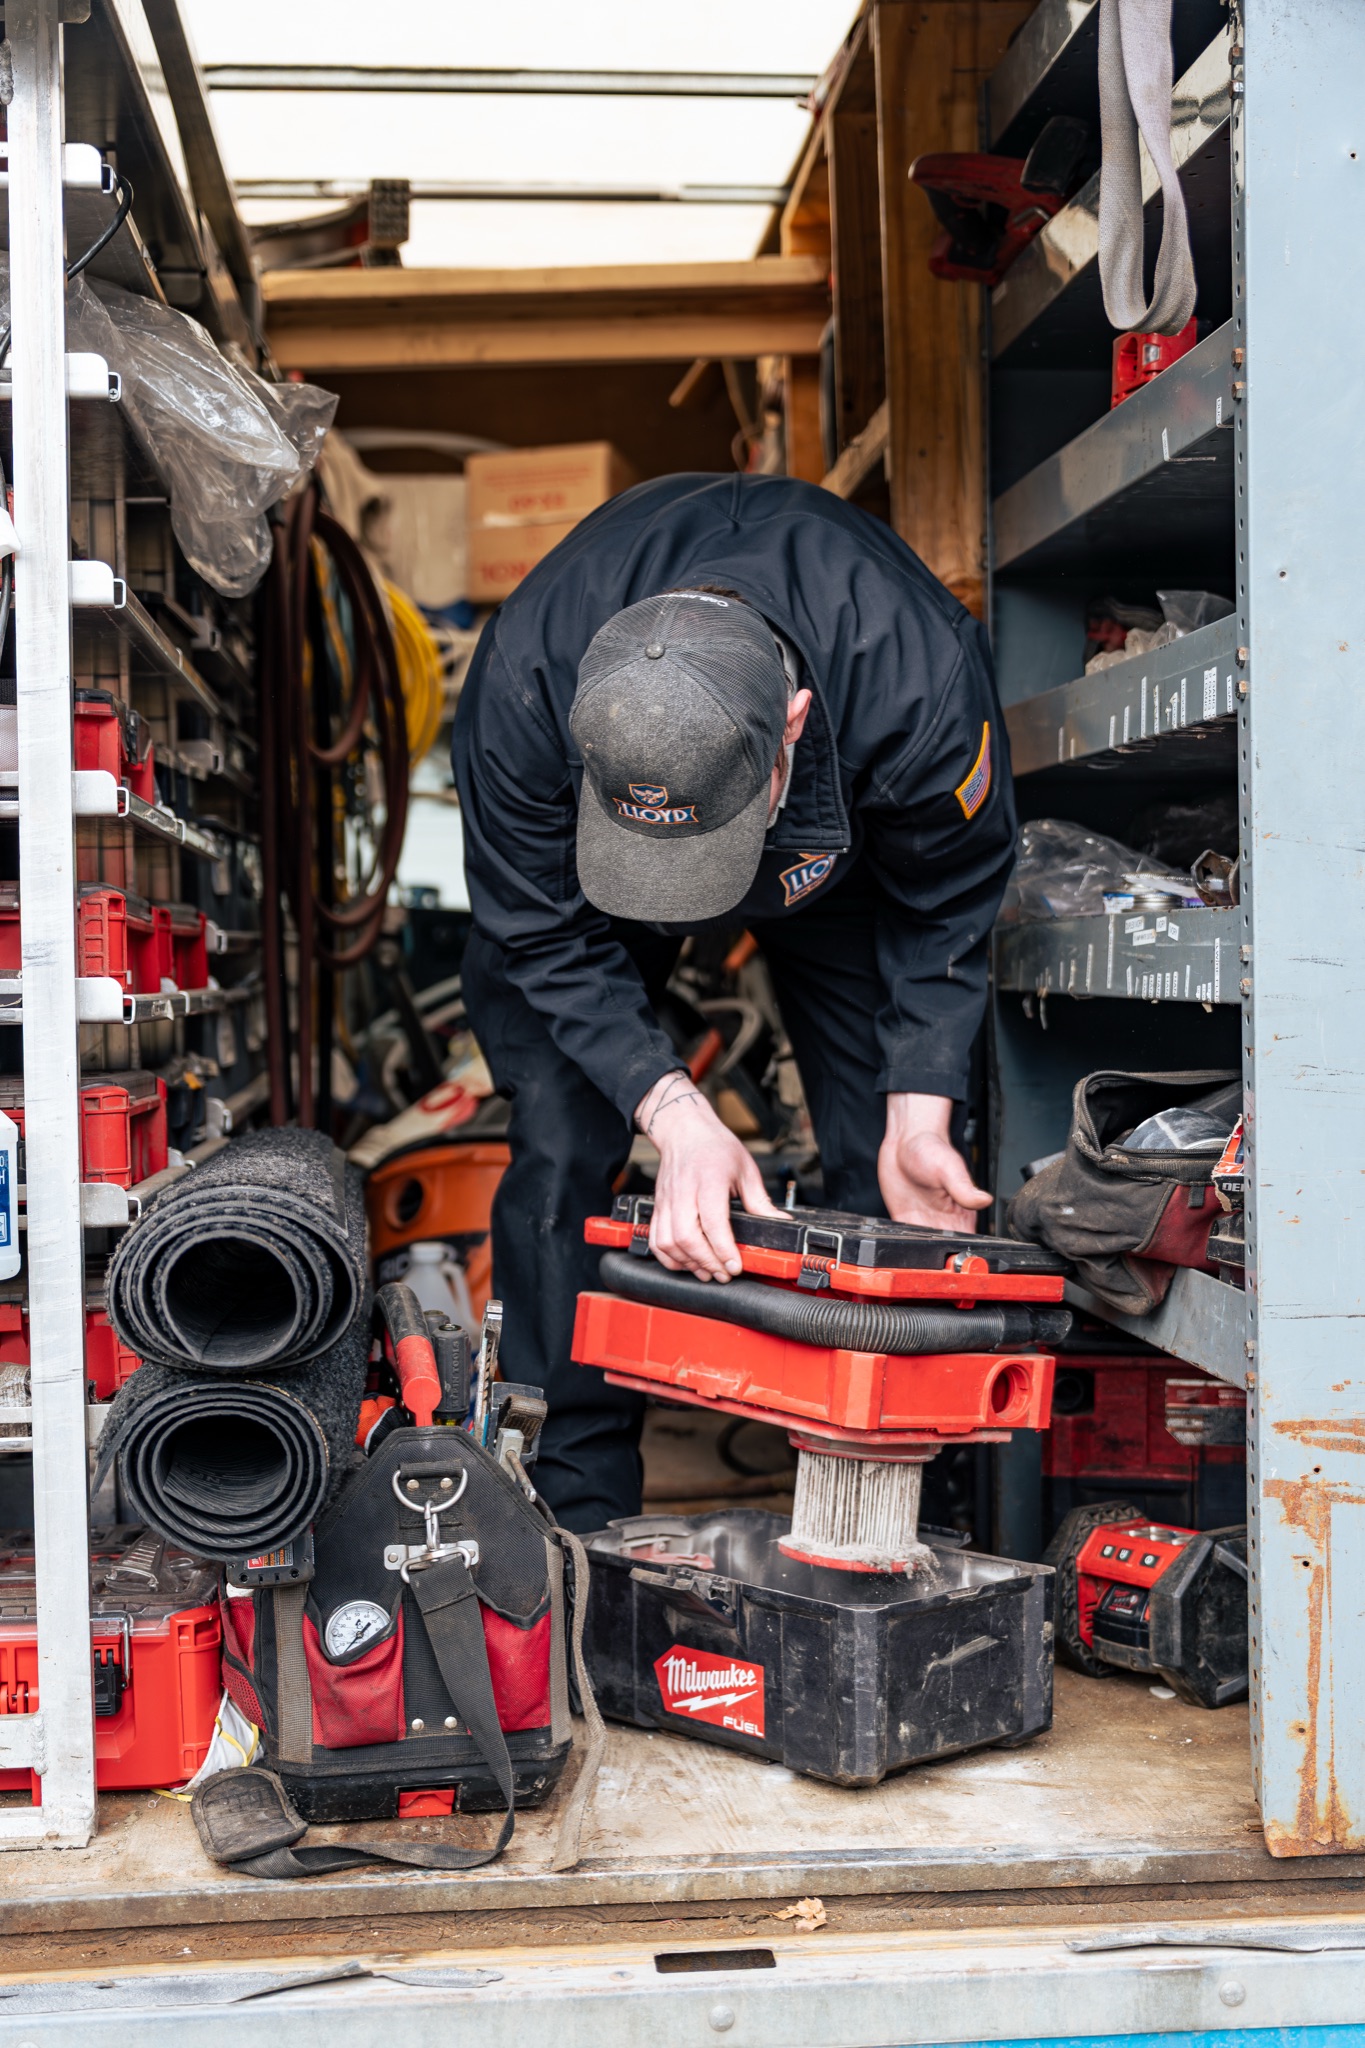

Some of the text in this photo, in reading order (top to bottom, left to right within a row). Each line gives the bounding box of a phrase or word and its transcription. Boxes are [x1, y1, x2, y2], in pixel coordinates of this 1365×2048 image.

[622, 803, 688, 822] LLOYD
[662, 1654, 757, 1696] Milwaukee
[722, 1715, 764, 1737] FUEL
